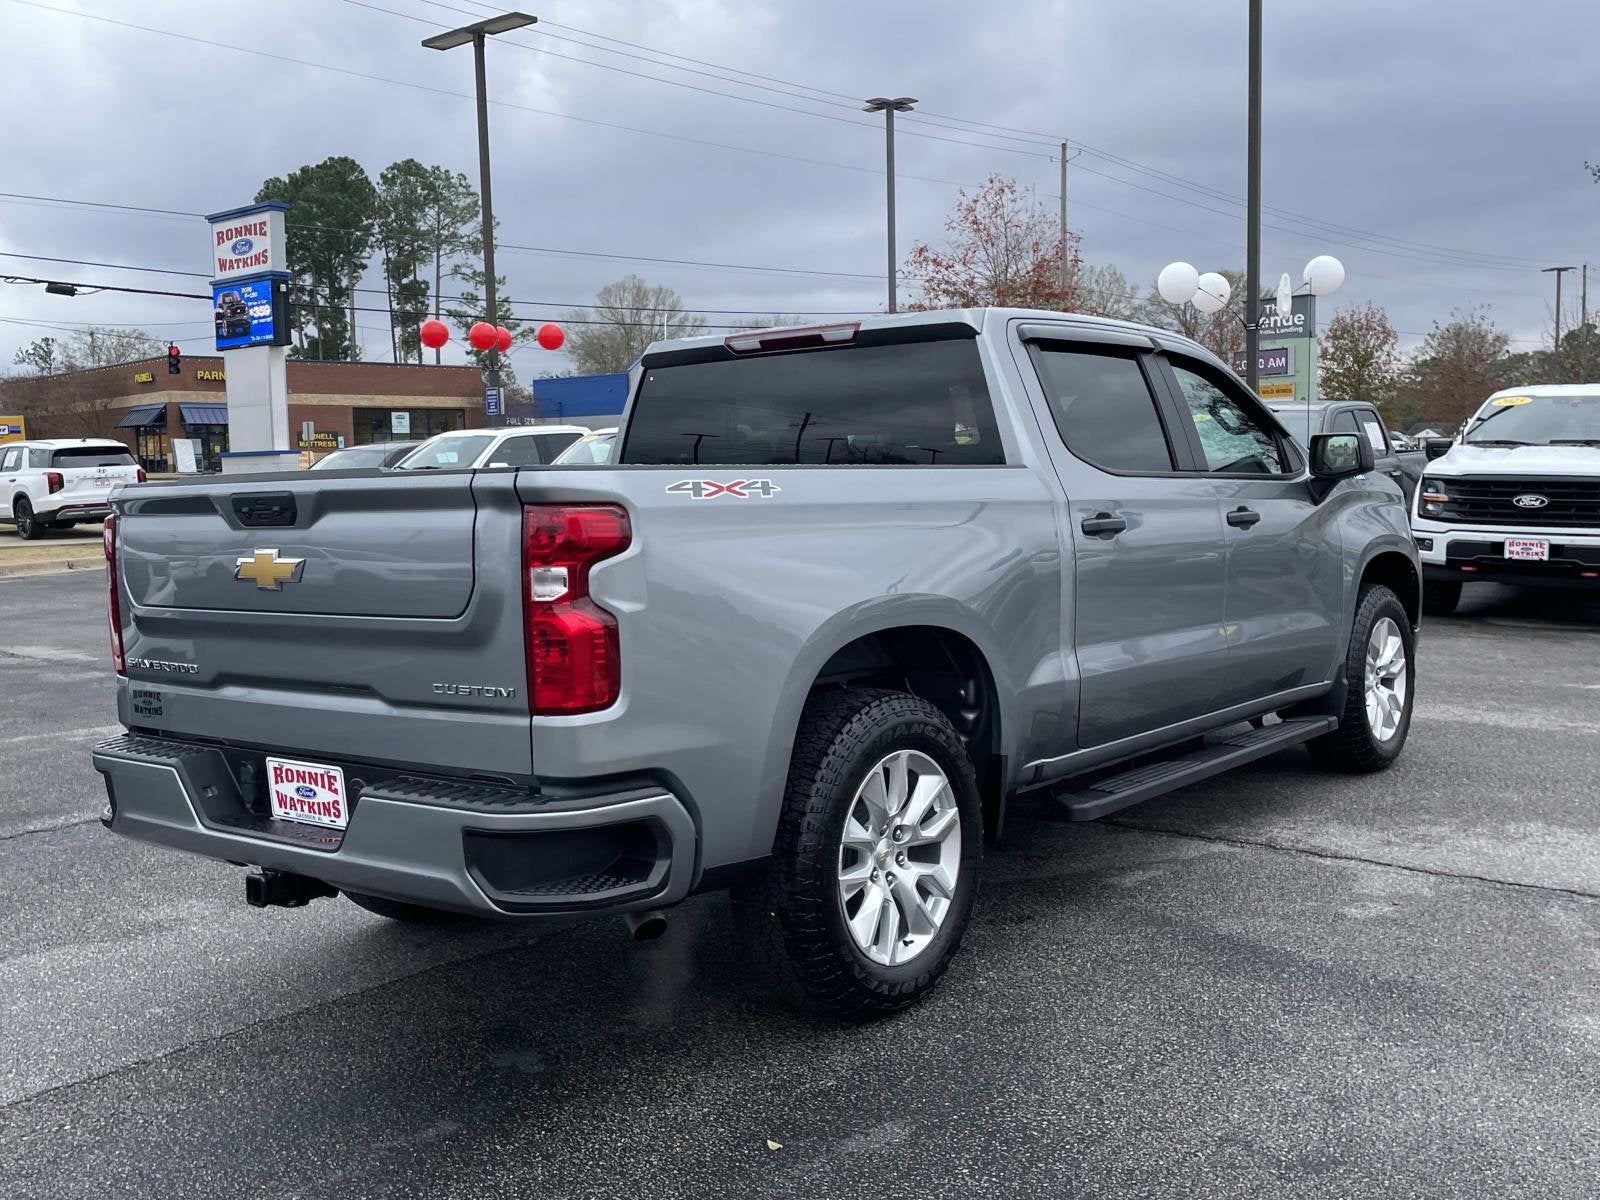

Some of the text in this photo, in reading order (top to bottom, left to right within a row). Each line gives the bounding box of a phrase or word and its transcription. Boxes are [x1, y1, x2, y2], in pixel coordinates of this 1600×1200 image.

[216, 221, 268, 246] RONNIE
[218, 249, 269, 273] WATKINS
[1264, 304, 1278, 314] Th
[1268, 357, 1286, 368] AM
[1508, 540, 1546, 550] RONNIE
[1508, 549, 1546, 558] WATKINS
[127, 657, 200, 675] SILVERADO
[132, 690, 162, 702] RONNIE
[433, 683, 516, 699] CUSTOM
[133, 703, 163, 717] WATKINS
[273, 766, 339, 796] RONNIE
[298, 786, 315, 798] Ford
[275, 789, 342, 819] WATKINS
